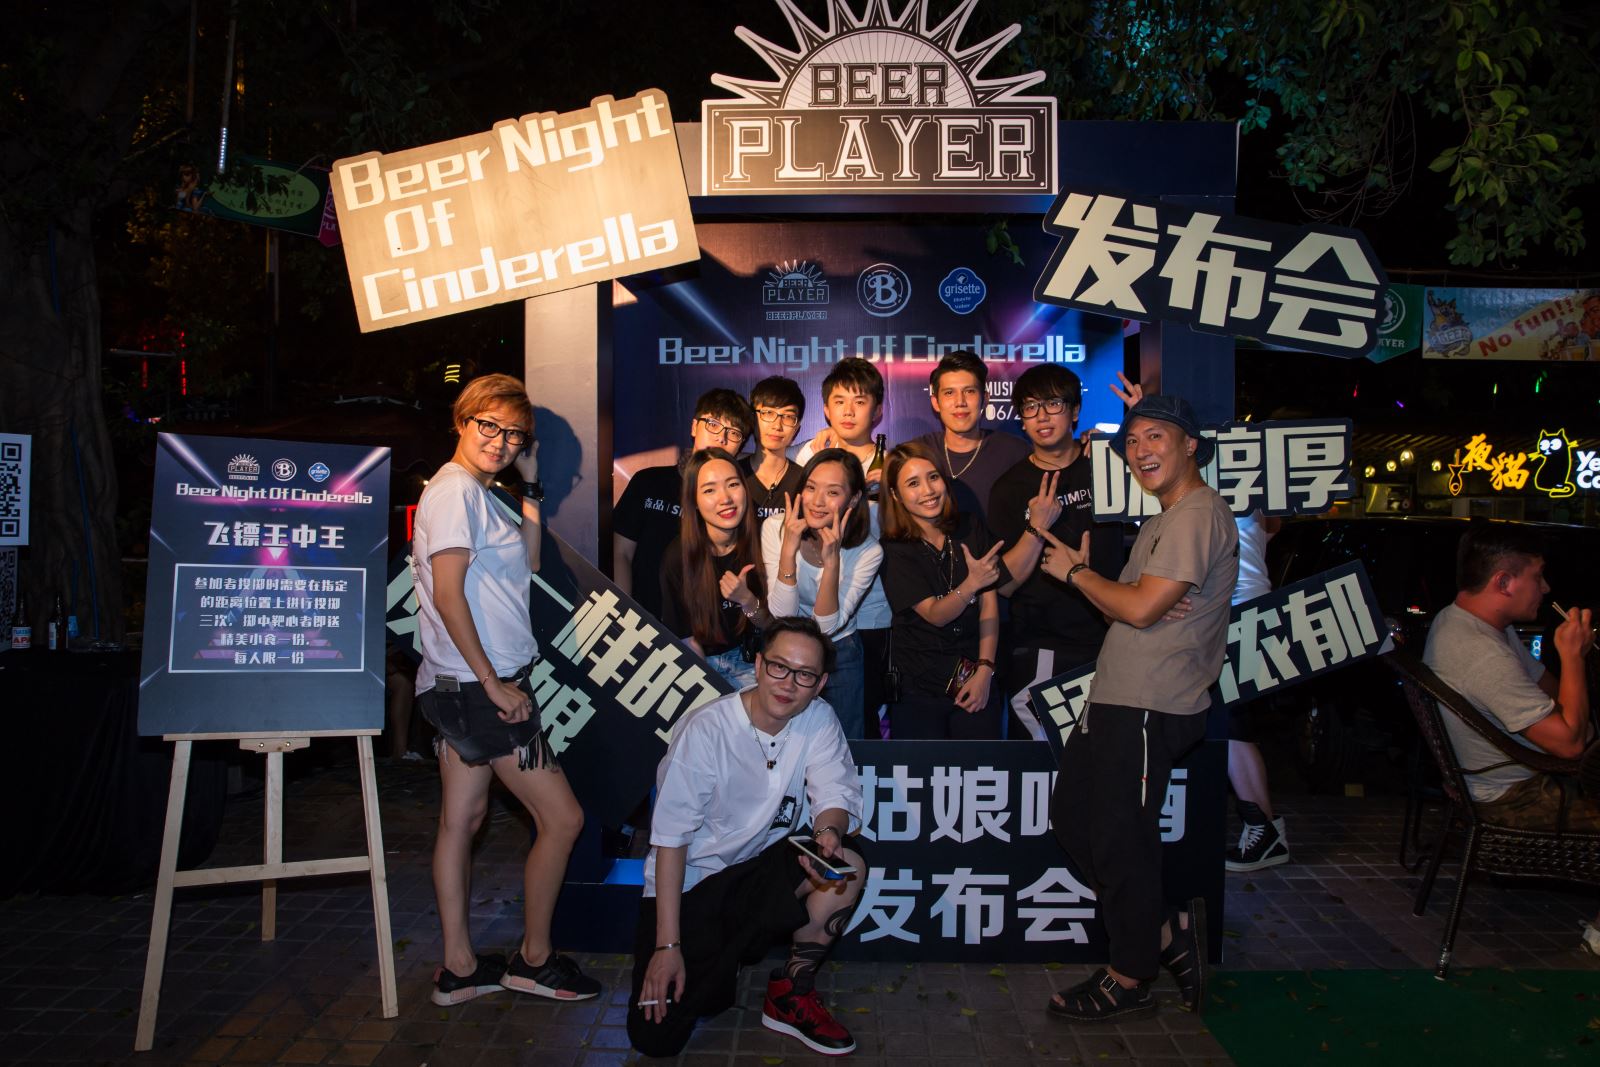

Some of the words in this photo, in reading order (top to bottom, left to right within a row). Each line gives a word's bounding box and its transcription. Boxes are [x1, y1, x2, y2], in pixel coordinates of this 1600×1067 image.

[808, 62, 949, 108] BEER
[338, 146, 491, 211] Beer
[498, 95, 671, 173] Night
[723, 115, 1035, 182] PLAYER
[383, 198, 455, 259] Of
[362, 213, 679, 321] Cinderella
[1042, 192, 1381, 350] 发布会
[767, 288, 825, 301] PLAYER
[783, 279, 809, 288] BEER
[944, 283, 981, 297] grisette
[766, 311, 828, 321] BEERPLAYER
[658, 337, 748, 365] Beer
[753, 336, 848, 371] Night
[856, 335, 897, 363] Of
[904, 335, 1086, 363] Cinderella
[1477, 332, 1512, 357] No
[985, 382, 1014, 397] MUSI
[176, 482, 219, 496] Beer
[221, 485, 267, 501] Night
[269, 487, 289, 499] Of
[291, 488, 373, 504] Cinderella
[204, 521, 345, 549] 飞镖王中王
[194, 577, 348, 592] 参加者投掷时需要在指定
[200, 596, 341, 610] 的距离位置上进行投掷
[234, 651, 304, 664] 每人限一份
[842, 867, 1098, 945] 发布会
